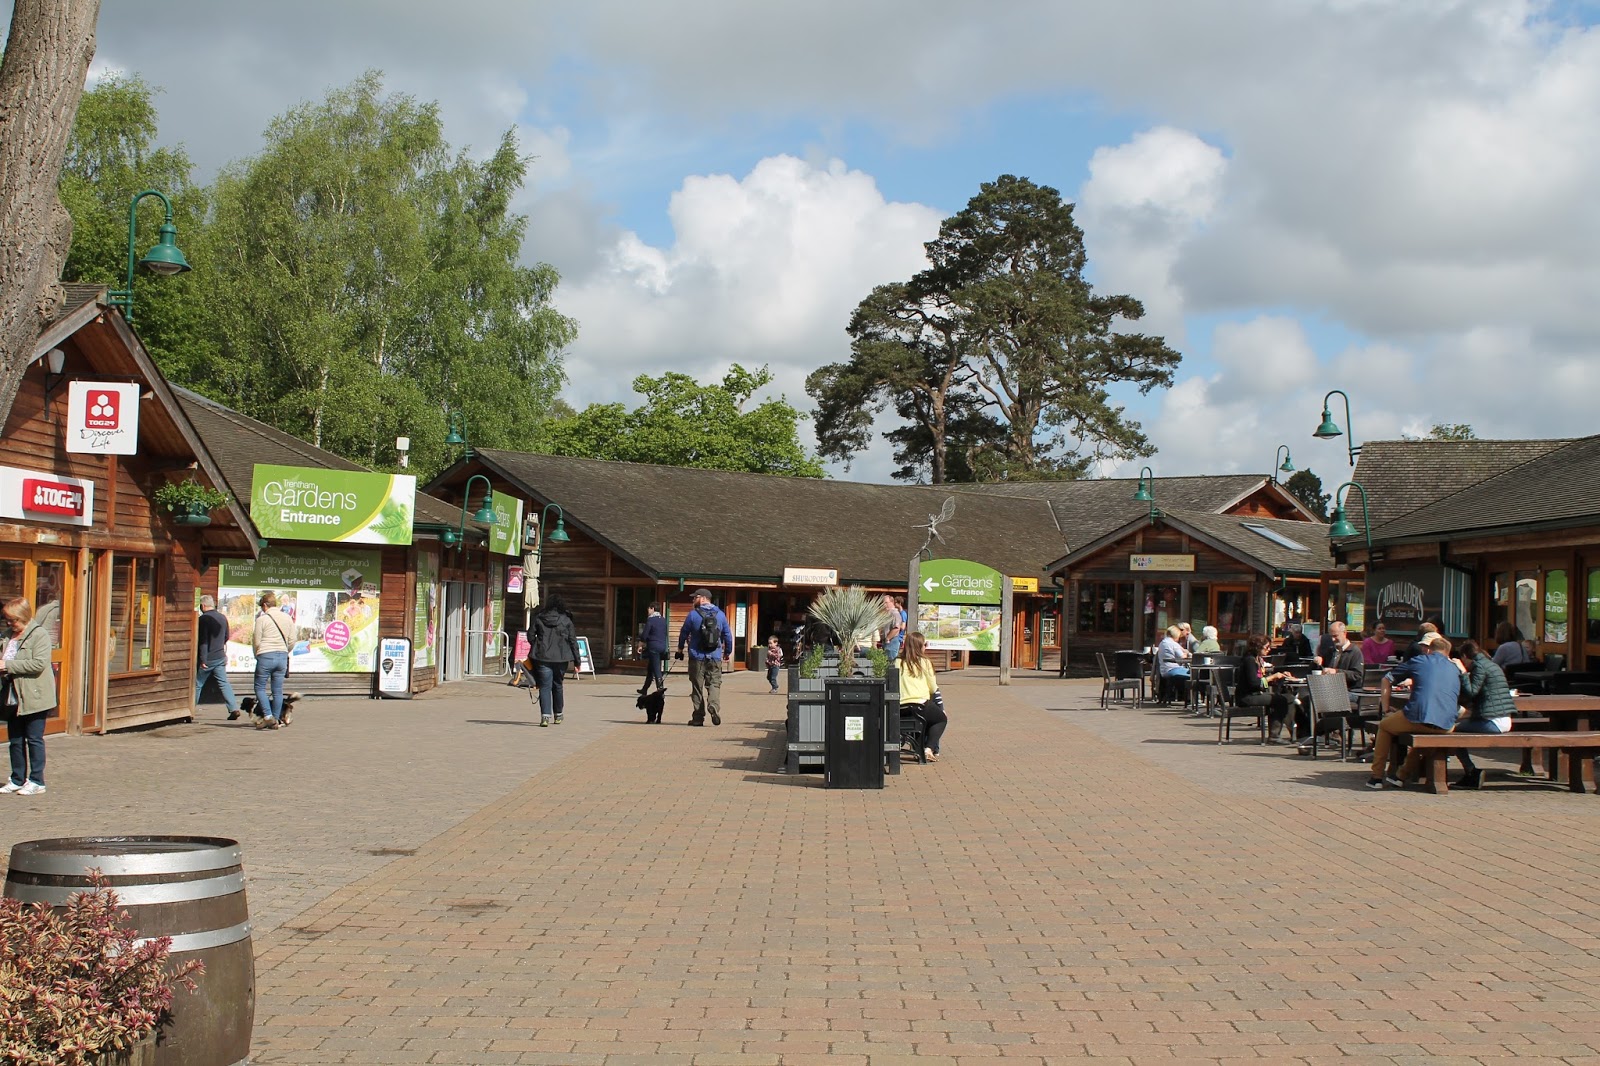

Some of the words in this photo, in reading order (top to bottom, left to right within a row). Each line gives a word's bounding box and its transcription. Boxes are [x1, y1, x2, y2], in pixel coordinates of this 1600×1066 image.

[80, 429, 124, 439] Discover
[92, 436, 110, 449] Life
[283, 479, 316, 489] Trentham
[42, 487, 82, 510] TOG24
[263, 481, 357, 510] Gardens
[281, 509, 341, 525] Entrance
[261, 555, 281, 564] Enjoy
[284, 555, 319, 565] Trentham
[320, 557, 329, 565] all
[330, 559, 346, 567] year
[348, 559, 370, 567] round
[261, 566, 277, 574] with
[290, 567, 317, 575] Annual
[318, 567, 340, 576] Ticket
[309, 578, 322, 586] gift
[792, 574, 829, 583] SHUROPODY
[941, 575, 993, 589] Gardens
[951, 588, 985, 596] Entrance
[1376, 581, 1425, 621] CADWALADERS
